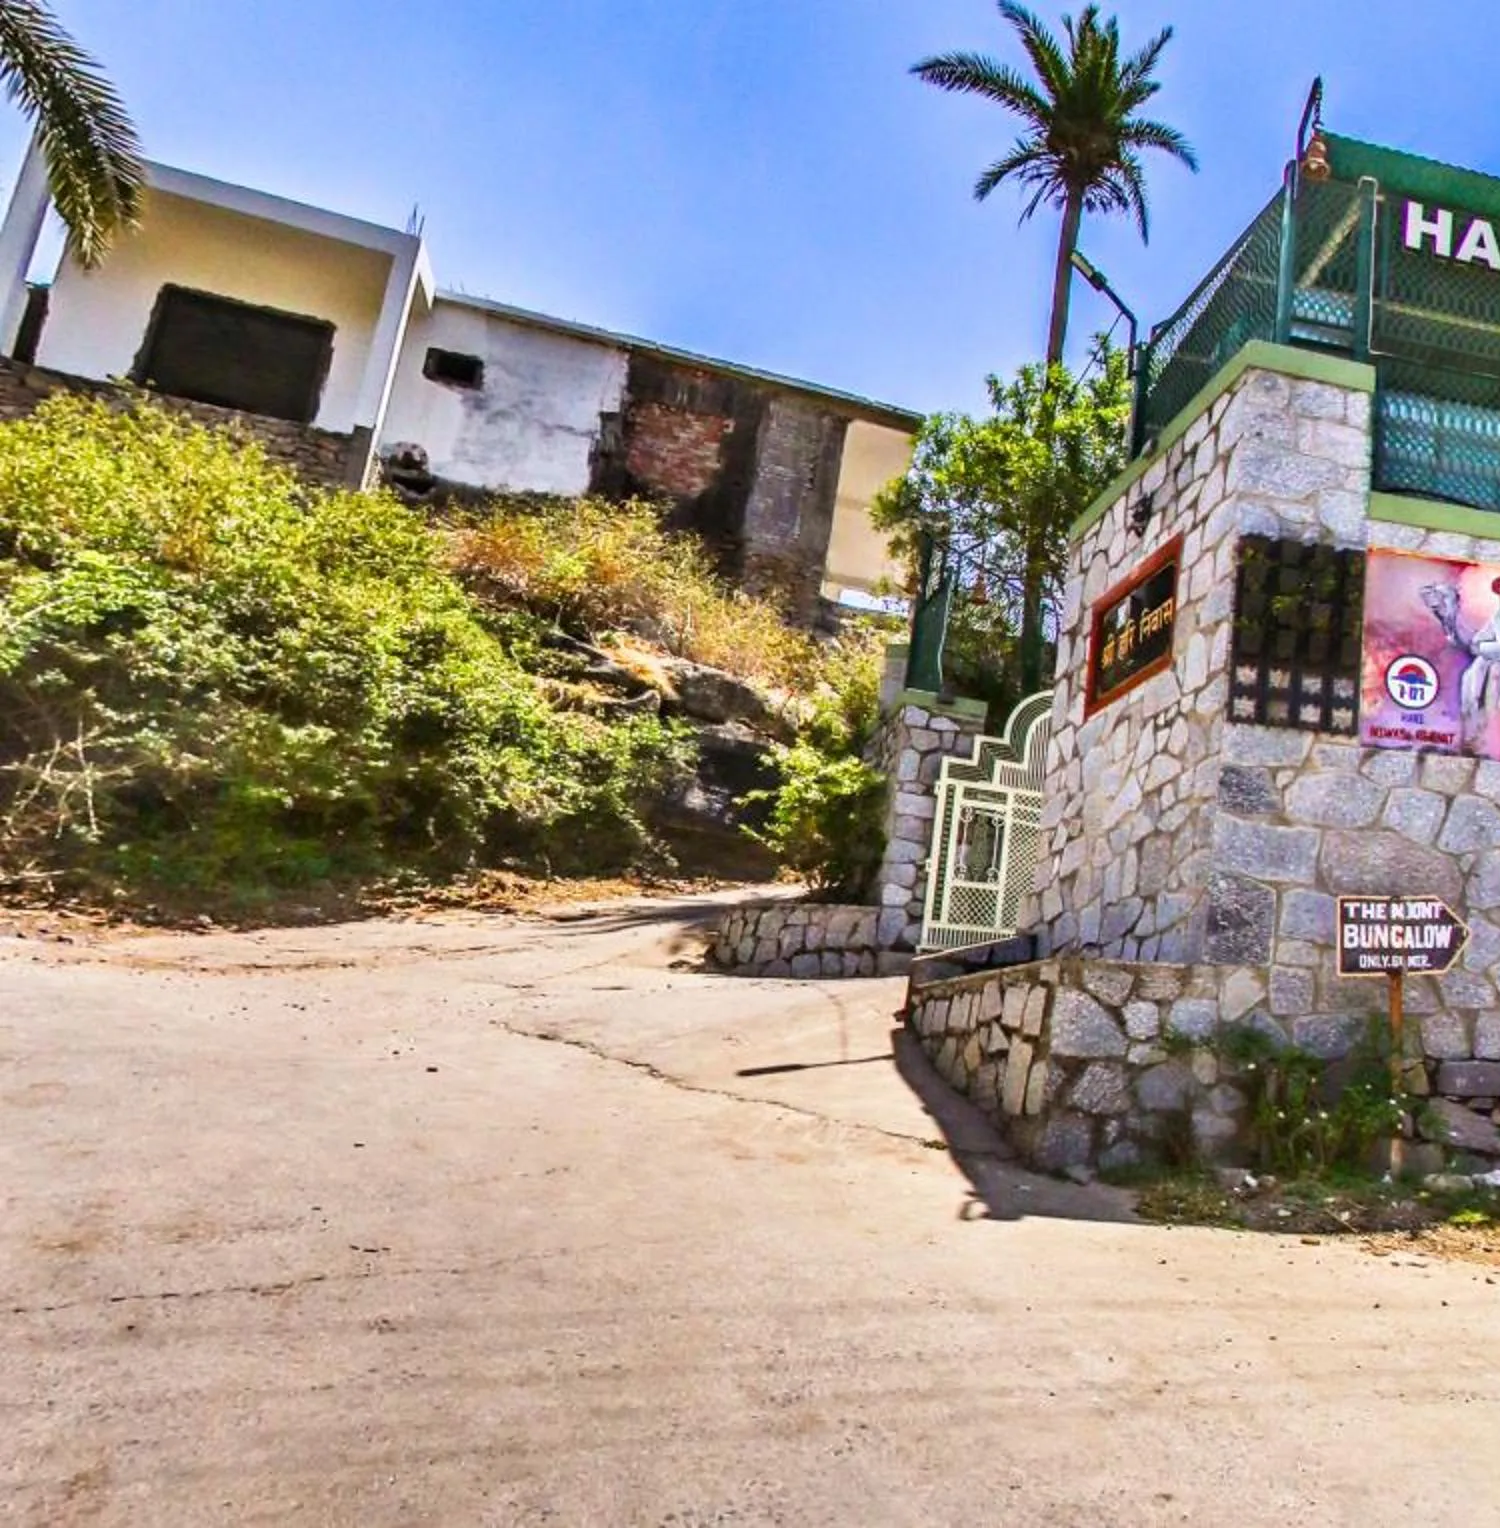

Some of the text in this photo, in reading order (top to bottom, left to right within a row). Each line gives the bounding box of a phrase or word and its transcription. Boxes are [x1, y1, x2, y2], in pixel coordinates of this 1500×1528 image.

[1139, 596, 1174, 645] निवास
[1344, 902, 1386, 918] THE
[1343, 923, 1453, 949] BUNGALOW
